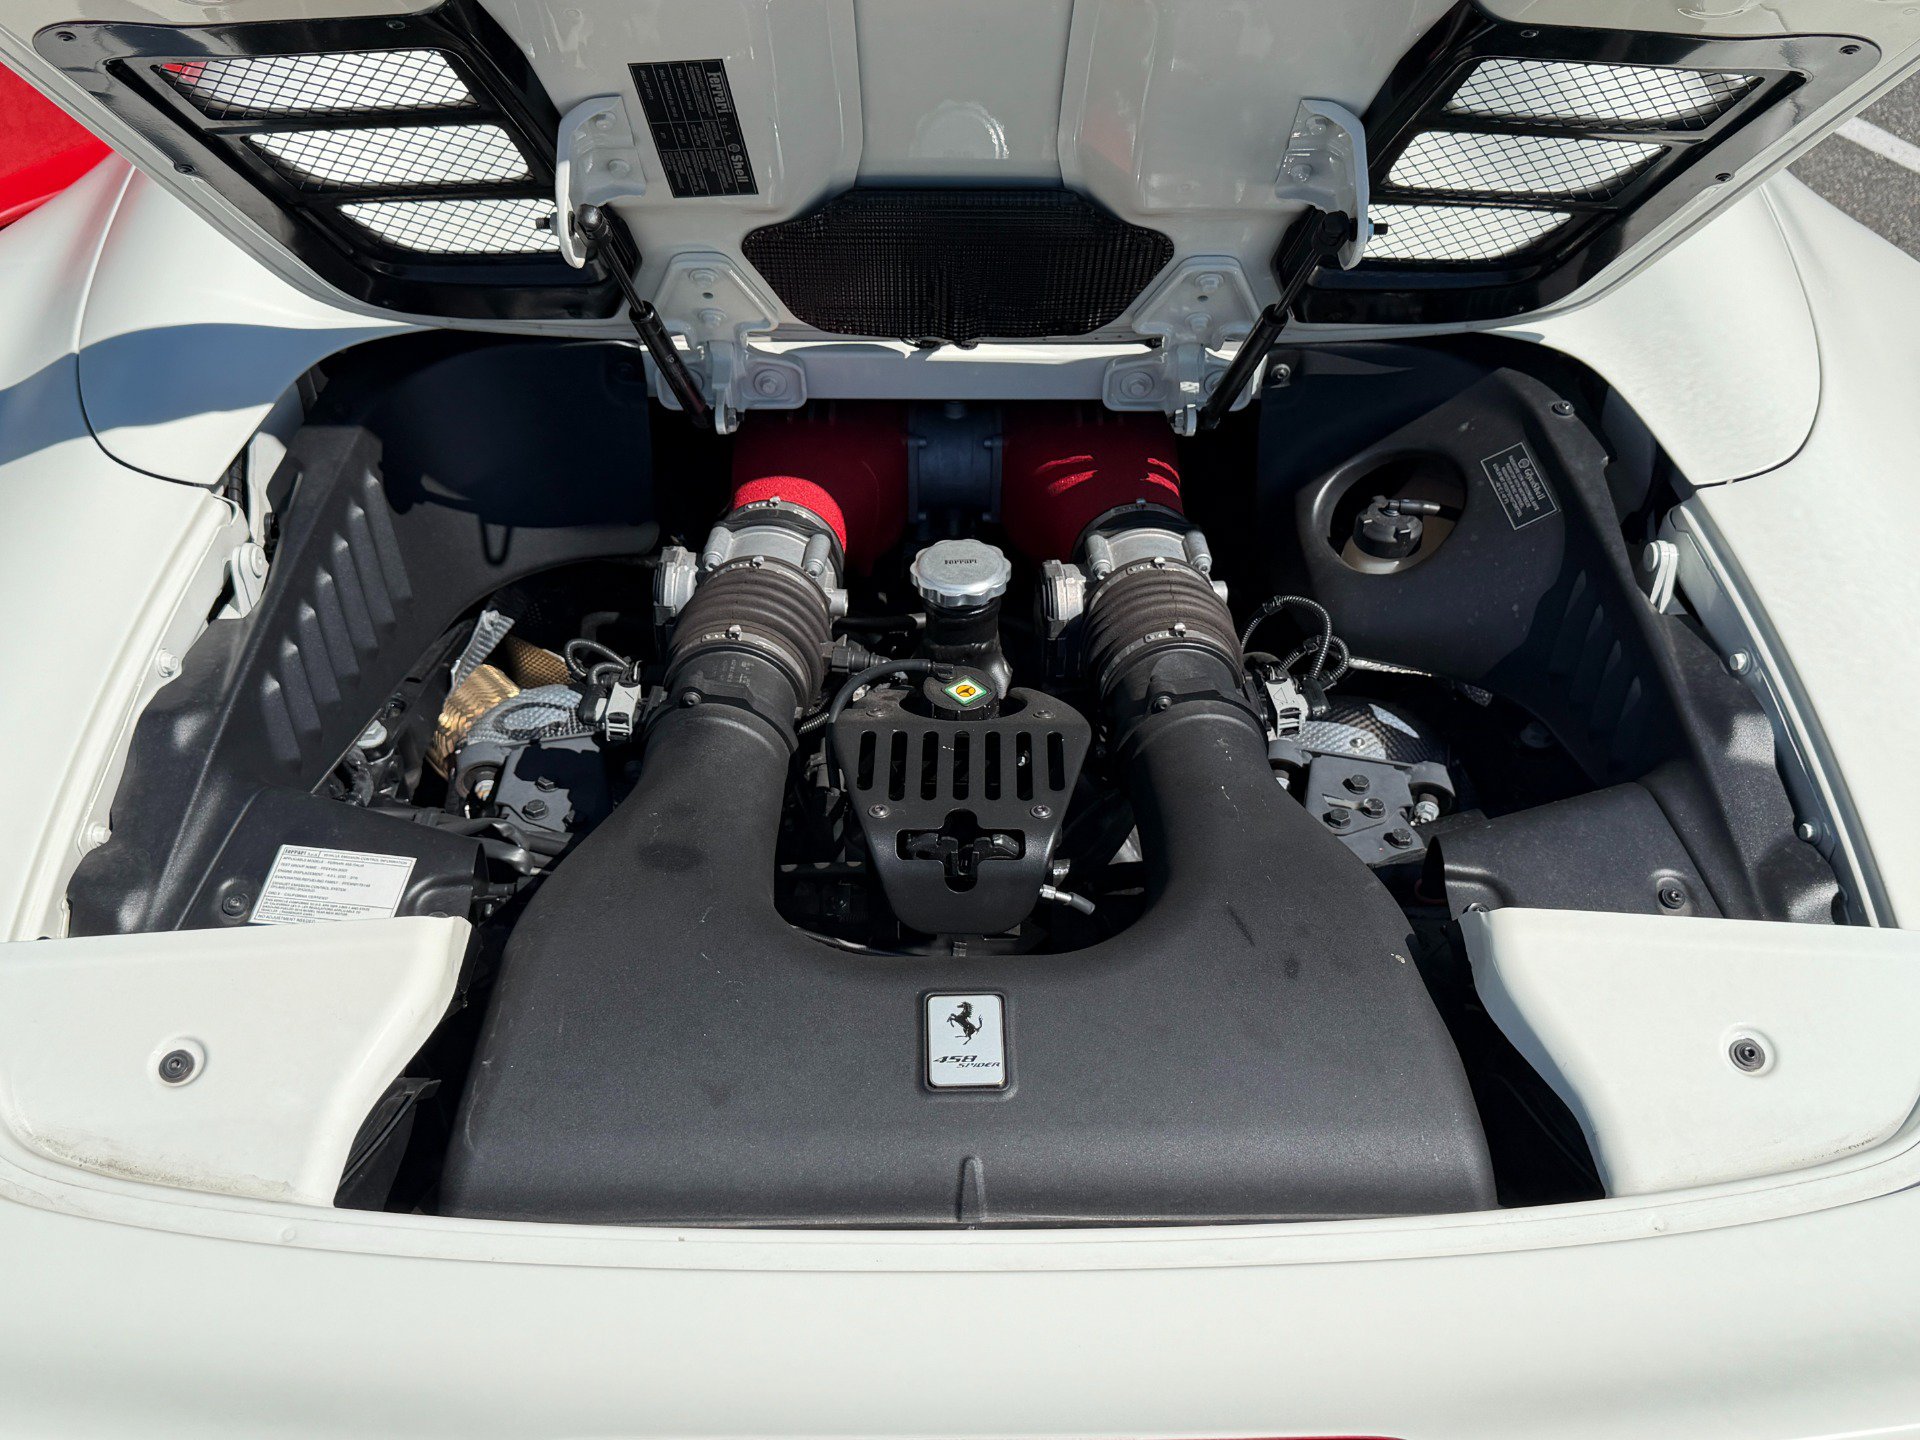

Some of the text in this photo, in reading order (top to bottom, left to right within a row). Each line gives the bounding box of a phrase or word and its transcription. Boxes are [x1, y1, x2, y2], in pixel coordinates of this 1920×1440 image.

[707, 72, 732, 113] Ferrari
[731, 154, 749, 183] Shell
[933, 1055, 978, 1063] 458
